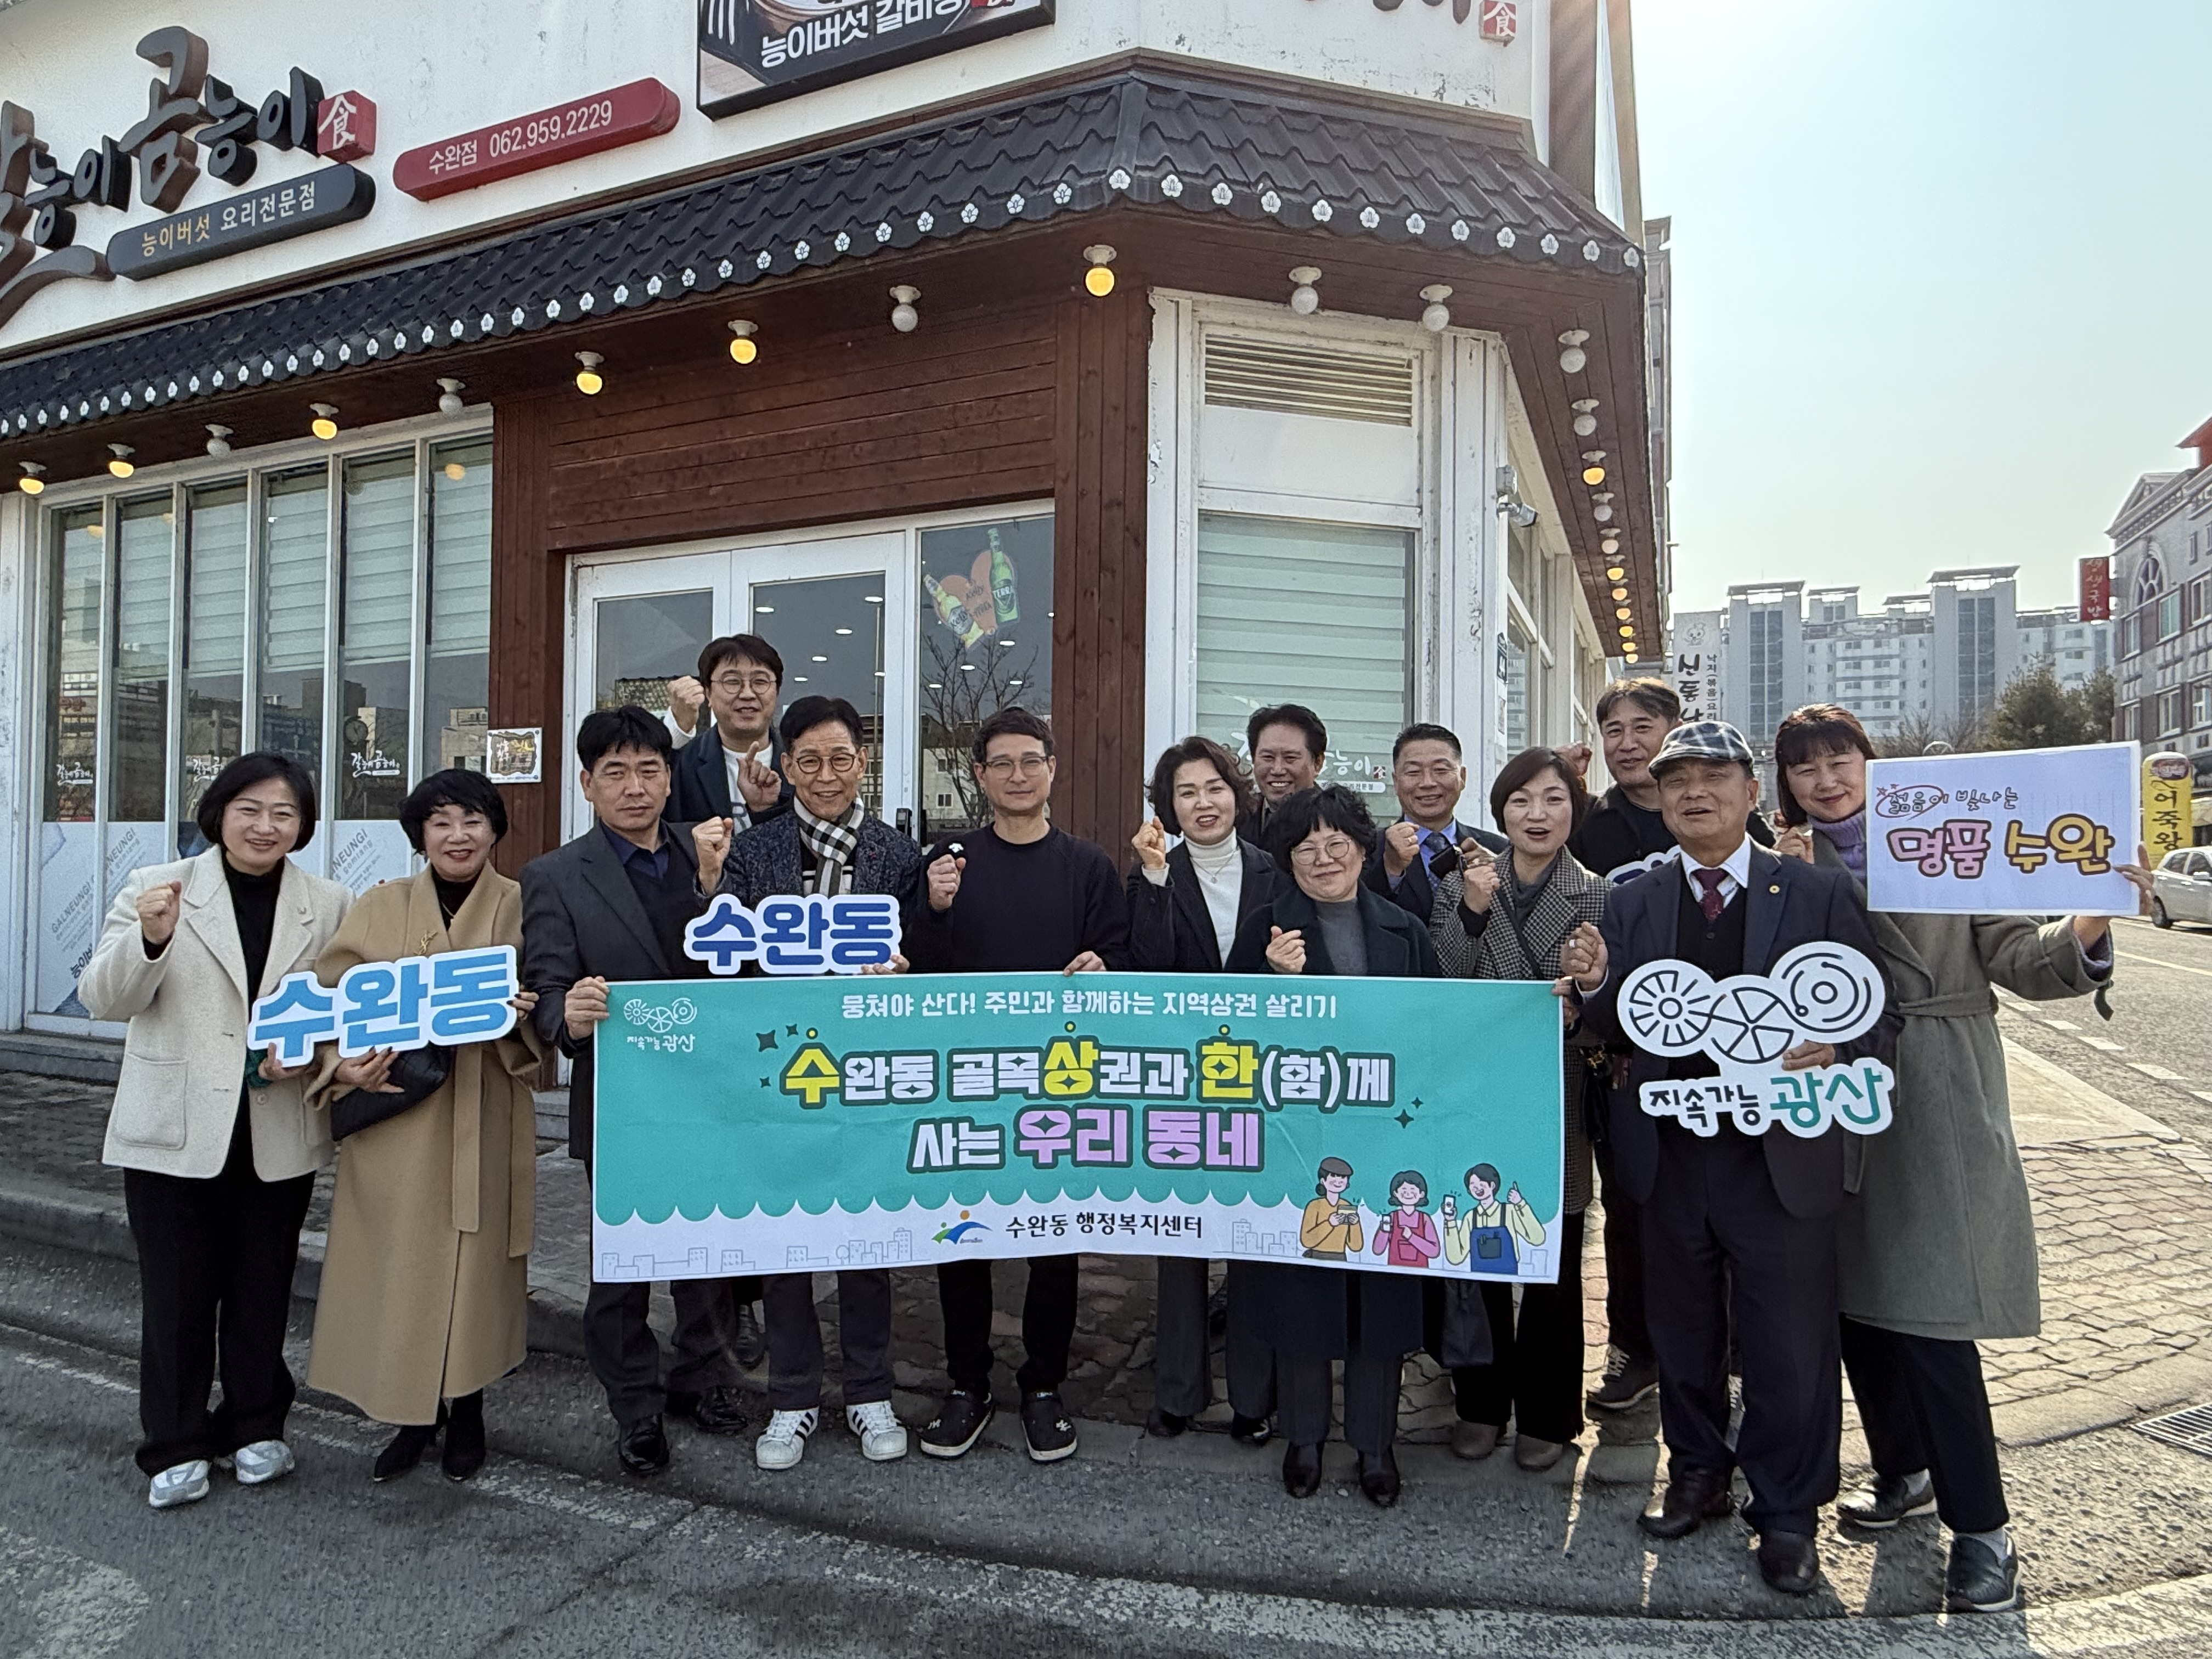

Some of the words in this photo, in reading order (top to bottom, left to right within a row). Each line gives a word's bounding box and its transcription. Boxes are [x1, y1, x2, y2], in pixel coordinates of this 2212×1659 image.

[760, 9, 868, 68] 능이버섯
[429, 139, 478, 174] 수완점
[489, 100, 613, 158] 062.959.2229
[141, 213, 211, 257] 능이버섯
[221, 180, 316, 232] 요리전문점
[1956, 787, 2018, 811] 빛나는
[2152, 790, 2183, 851] 어죽왕
[1887, 819, 1991, 879] 명품
[691, 901, 894, 967] 수완동
[254, 952, 511, 1059] 수완동
[842, 994, 914, 1019] 뭉쳐야
[921, 992, 977, 1017] 산다!
[984, 991, 1056, 1015] 주민과
[1062, 990, 1155, 1015] 함께하는
[1162, 992, 1257, 1018] 지역상권
[1265, 994, 1337, 1019] 살리기
[662, 1034, 696, 1053] 광산
[782, 1046, 936, 1106] 수완동
[950, 1039, 1190, 1099] 골목상권과
[1200, 1040, 1392, 1109] 한(함)께
[1649, 1084, 1760, 1128] 지속가능
[1770, 1067, 1883, 1128] 광산
[911, 1121, 1001, 1170] 사는
[1017, 1107, 1129, 1165] 우리
[1146, 1109, 1260, 1168] 동네
[1005, 1214, 1069, 1239] 수완동
[1076, 1211, 1202, 1239] 행정복지센터
